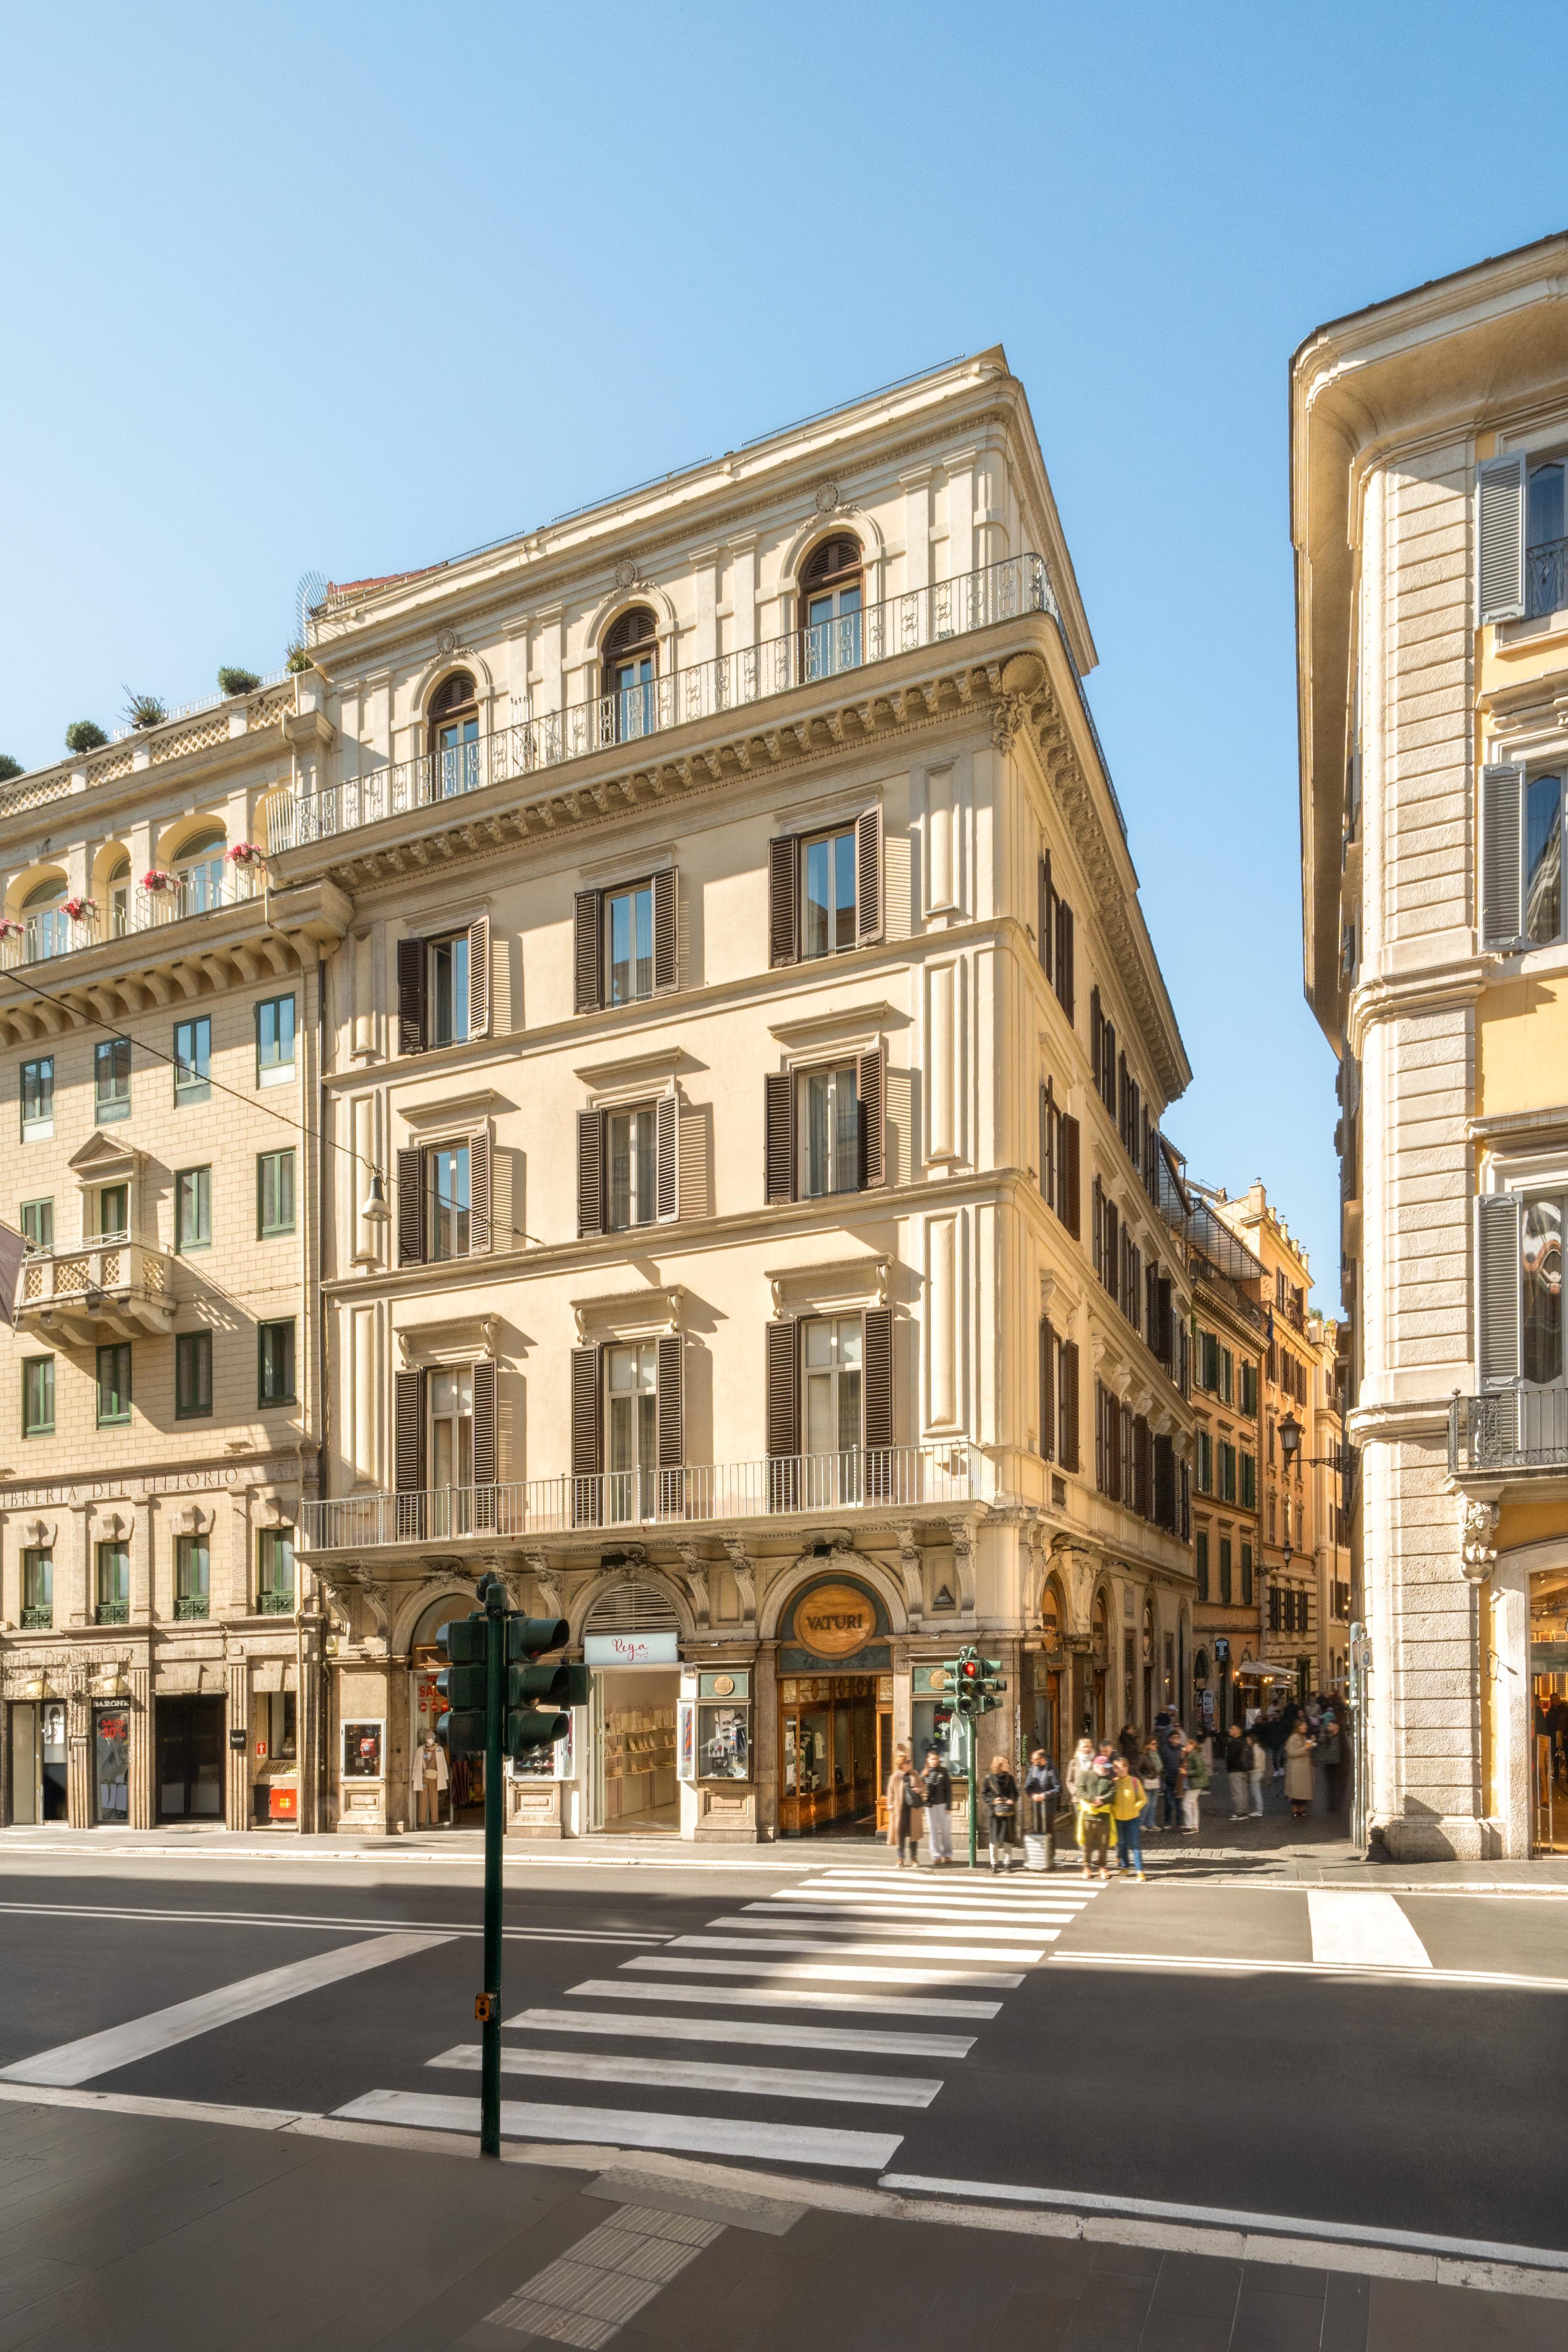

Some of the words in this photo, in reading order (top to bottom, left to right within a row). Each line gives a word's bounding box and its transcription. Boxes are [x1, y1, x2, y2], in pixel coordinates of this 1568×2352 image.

[3, 1486, 77, 1507] IBRERIA
[93, 1480, 126, 1498] DEL
[805, 1613, 862, 1631] VATURI
[612, 1639, 649, 1661] Rega
